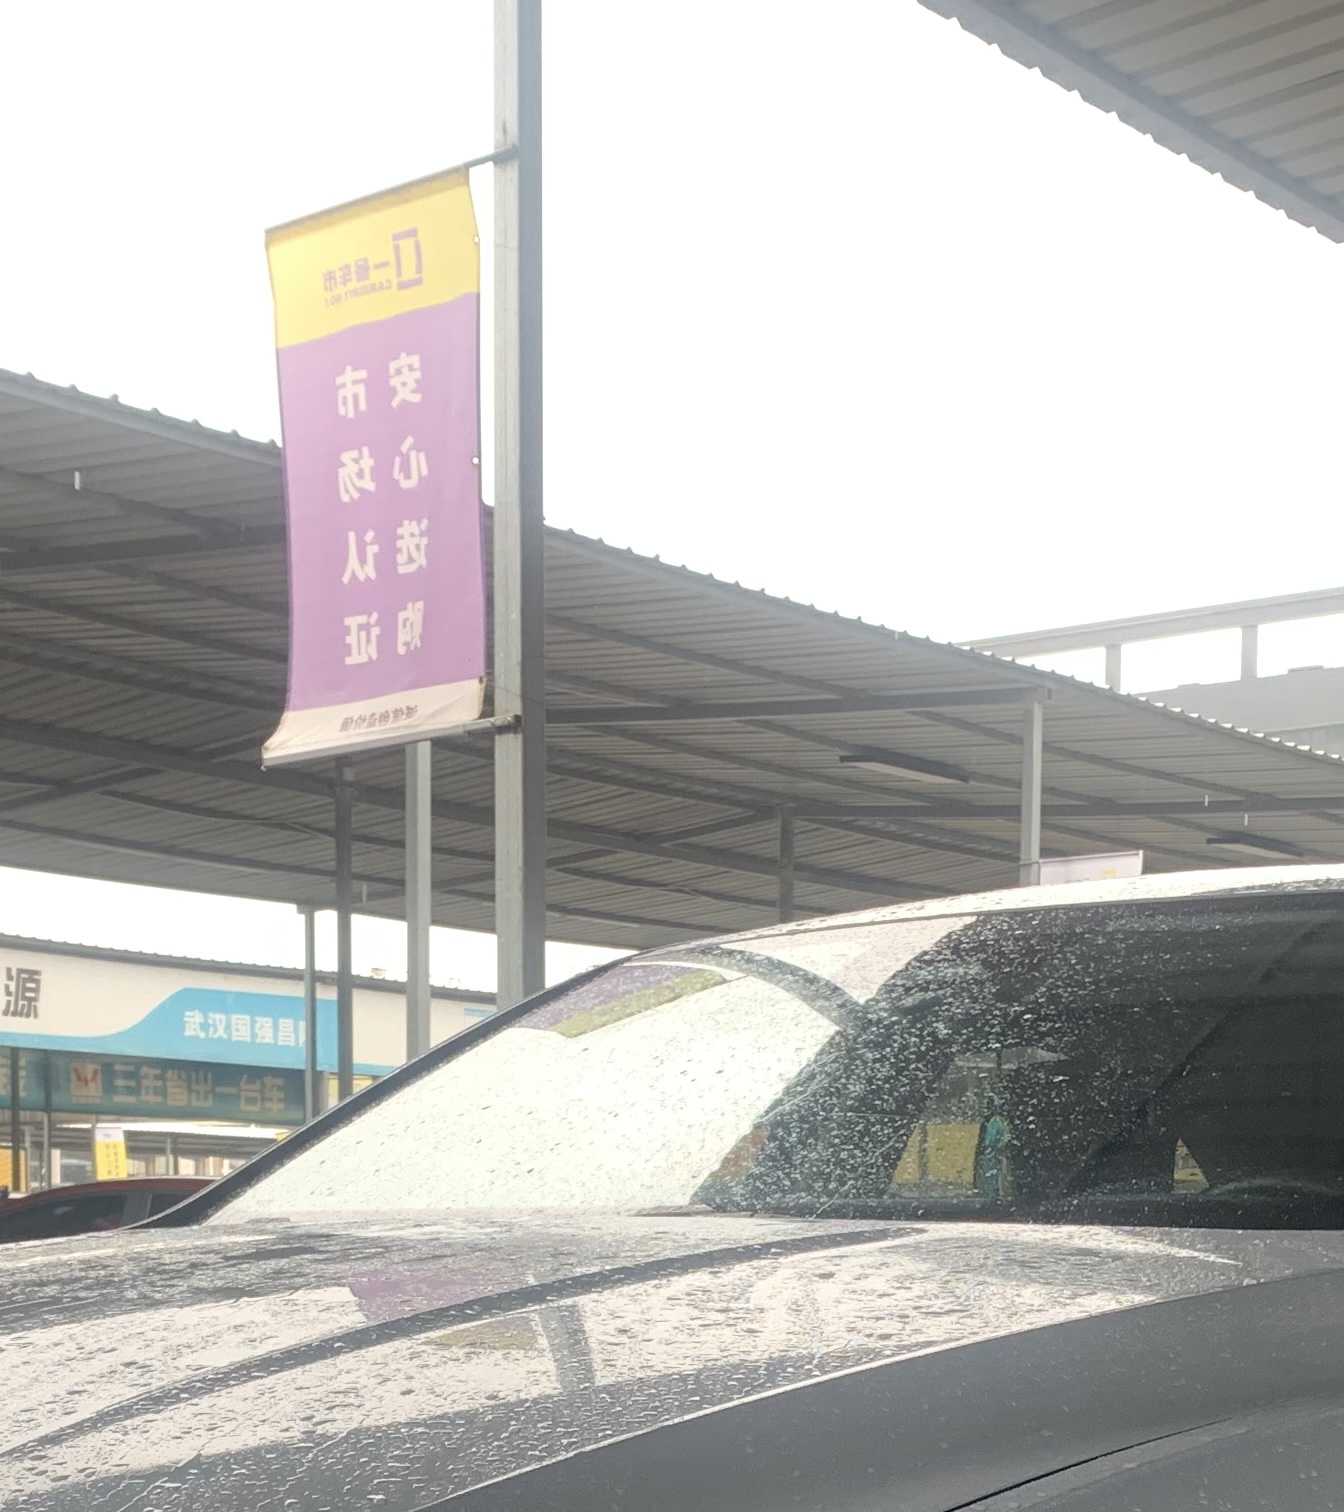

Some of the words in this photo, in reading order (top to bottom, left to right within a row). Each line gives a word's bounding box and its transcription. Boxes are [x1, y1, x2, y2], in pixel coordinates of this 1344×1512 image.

[113, 1063, 285, 1112] 三年省出一台车
